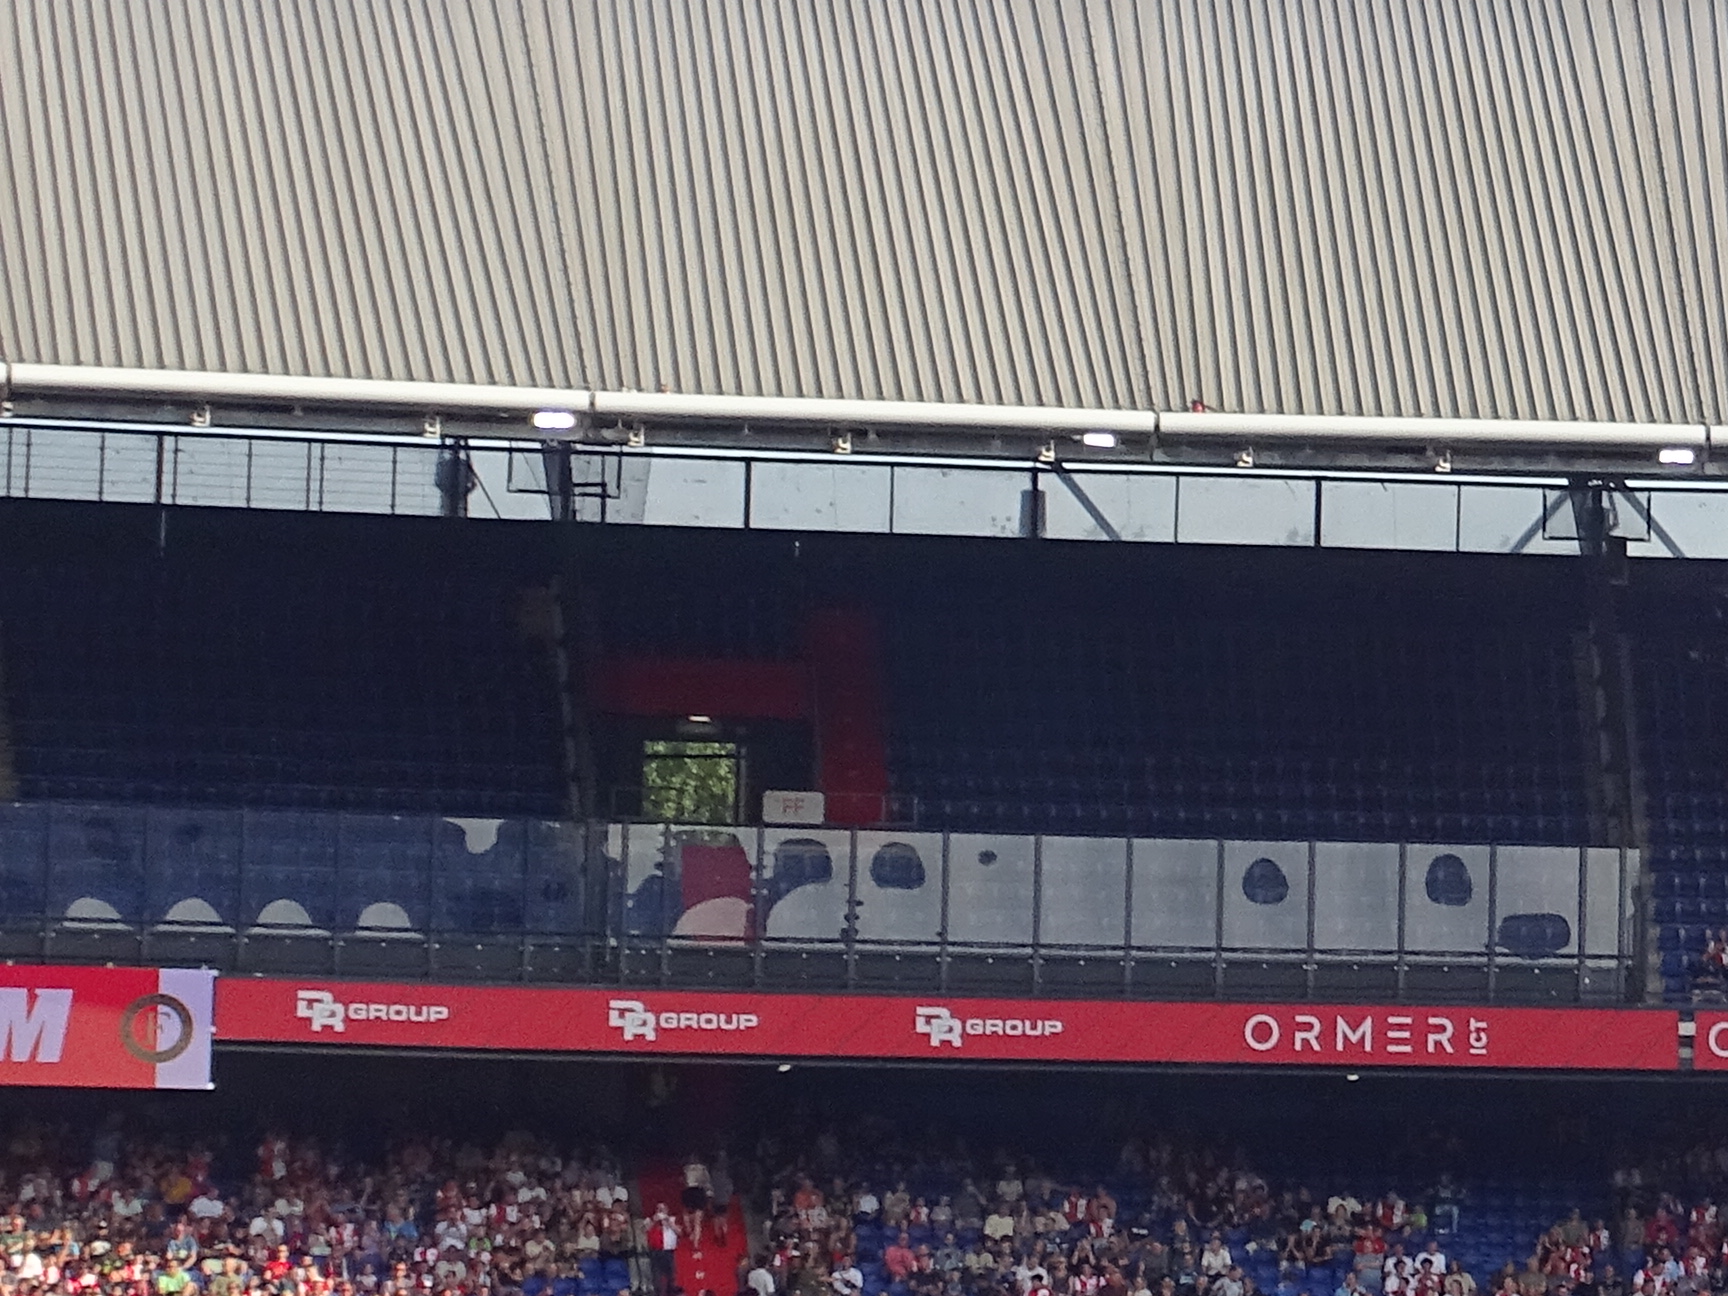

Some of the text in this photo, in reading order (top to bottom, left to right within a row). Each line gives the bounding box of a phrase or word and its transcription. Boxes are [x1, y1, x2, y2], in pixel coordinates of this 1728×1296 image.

[348, 1003, 449, 1022] GROUP
[659, 1012, 759, 1030] GROUP
[965, 1018, 1063, 1036] GROUP
[1244, 1014, 1454, 1054] ORMER
